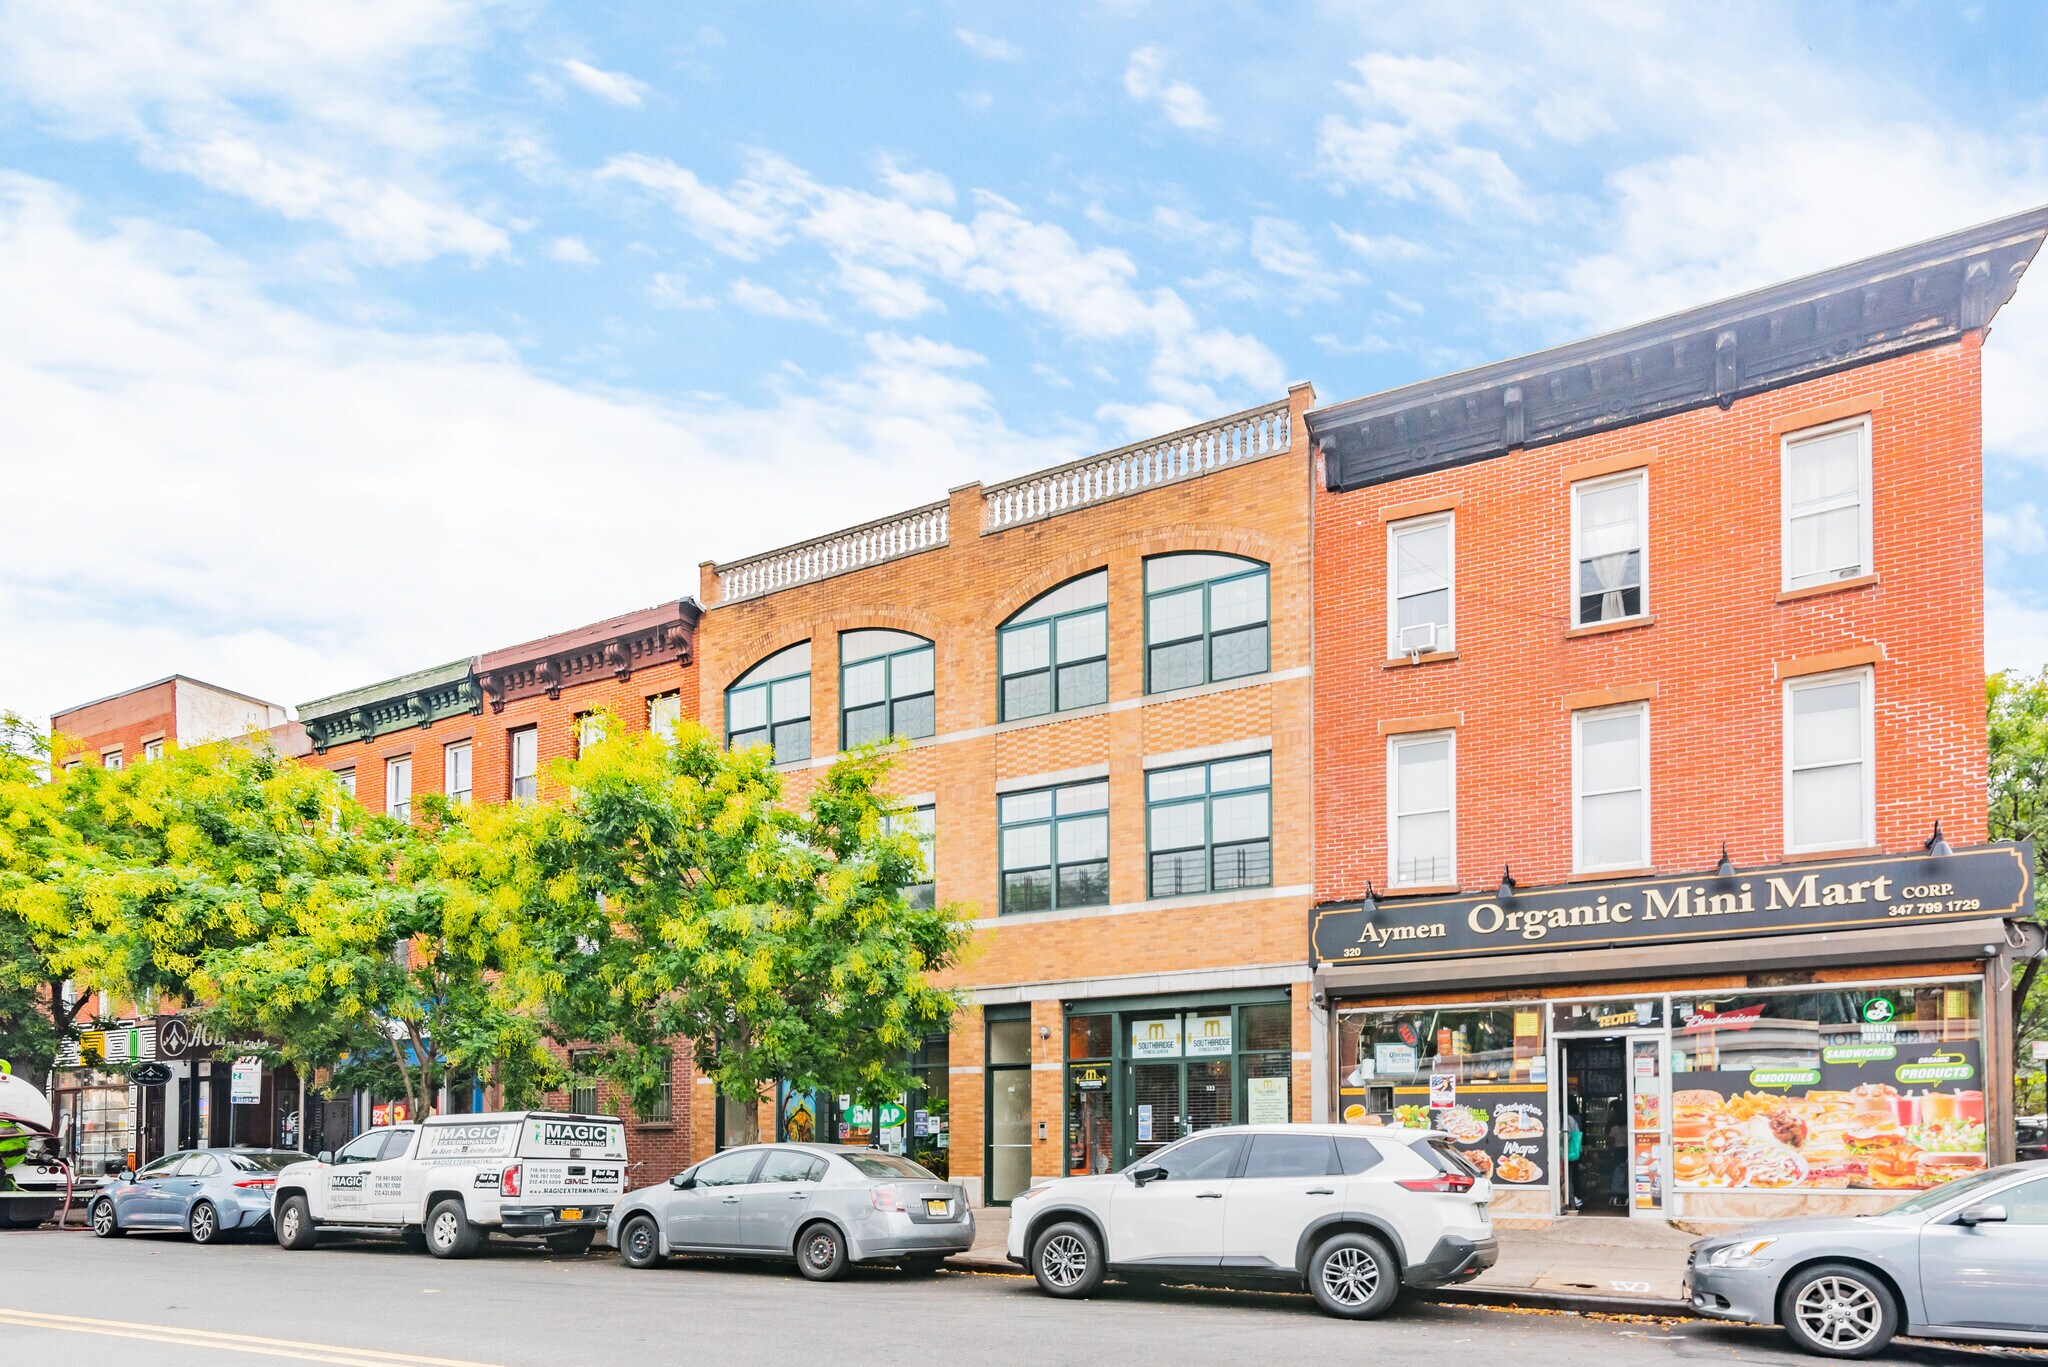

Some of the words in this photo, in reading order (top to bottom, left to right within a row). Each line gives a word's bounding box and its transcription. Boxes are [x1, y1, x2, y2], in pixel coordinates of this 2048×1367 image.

[1357, 921, 1447, 948] Aymen
[1467, 895, 1634, 940] Organic
[1641, 883, 1756, 921] Mini
[1765, 874, 1893, 912] Mart
[1902, 883, 1955, 899] CORP.
[1888, 904, 1914, 917] 347
[1917, 901, 1943, 915] 799
[1946, 898, 1981, 912] 1729
[1343, 948, 1362, 958] 320
[1597, 1011, 1638, 1028] TECATE
[1683, 1012, 1761, 1028] Budweiser
[1860, 1024, 1897, 1033] BROOKLYN
[1193, 1037, 1231, 1047] SOUTHBRIDGE
[1862, 1032, 1896, 1042] BREWERY
[1138, 1040, 1175, 1050] SOUTHBRIDGE
[1825, 1047, 1895, 1059] SANDWICHES
[1918, 1056, 1951, 1064] ORGANIC
[1753, 1073, 1815, 1083] SMOOTHIES
[1900, 1067, 1970, 1080] PRODUCTS
[440, 1126, 500, 1140] MAGIC
[546, 1124, 607, 1140] MAGIC
[439, 1138, 497, 1146] EXTERMINATING
[546, 1138, 606, 1147] EXTERMINATING
[1502, 1140, 1540, 1157] Wraps
[332, 1176, 362, 1186] MAGIC
